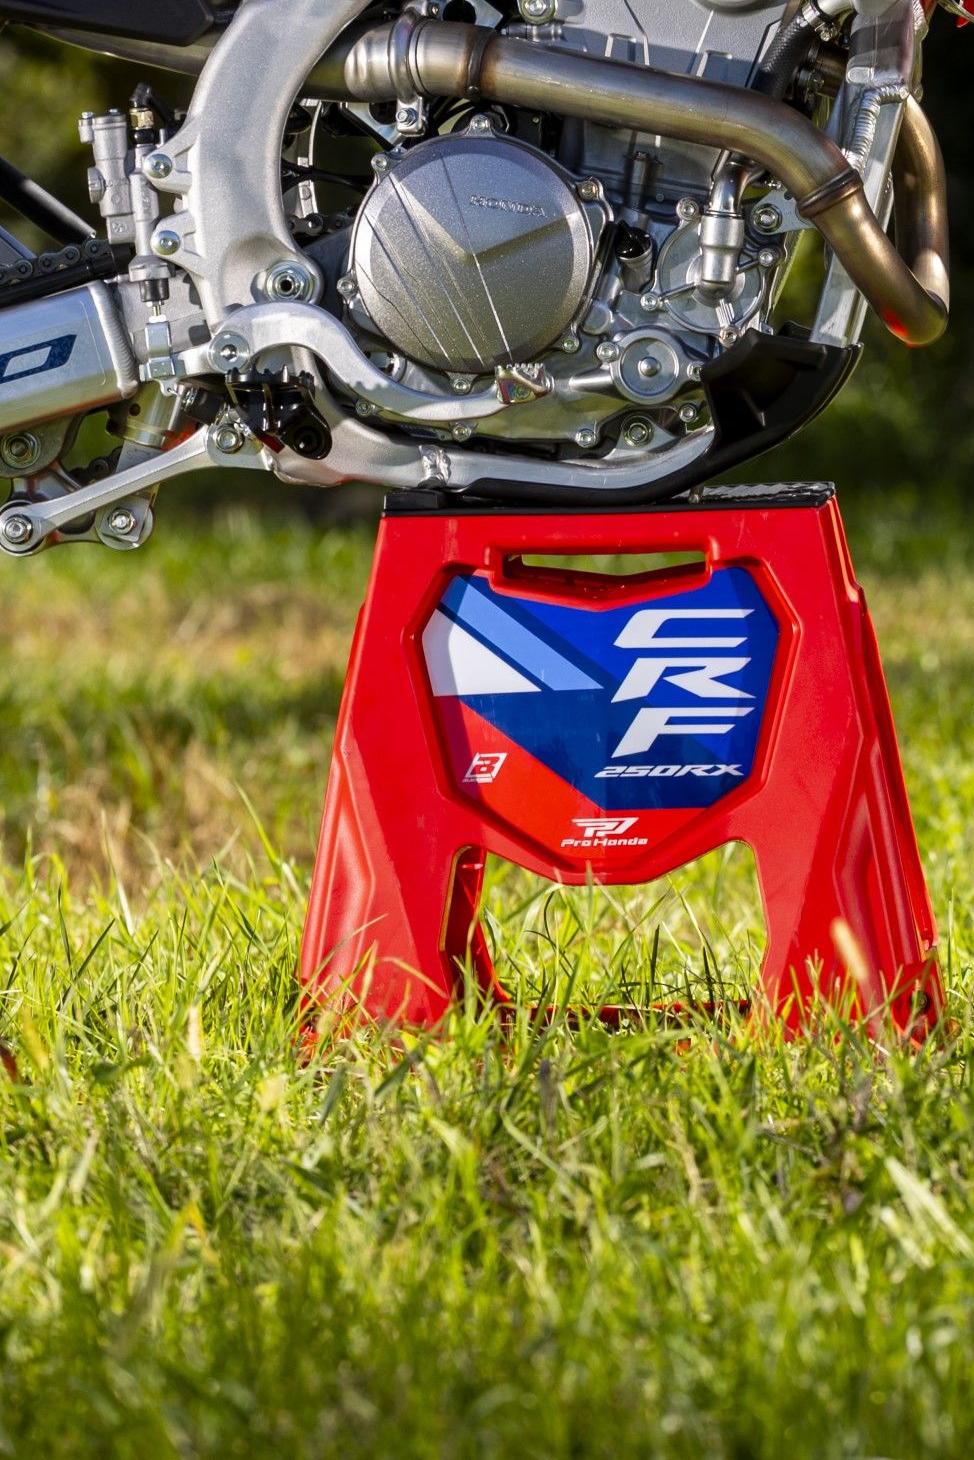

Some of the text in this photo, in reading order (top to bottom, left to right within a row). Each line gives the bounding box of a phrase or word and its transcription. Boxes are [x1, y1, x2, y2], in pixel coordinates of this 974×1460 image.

[469, 194, 548, 218] HONDA
[611, 608, 756, 759] CRF
[594, 763, 745, 779] 250RX
